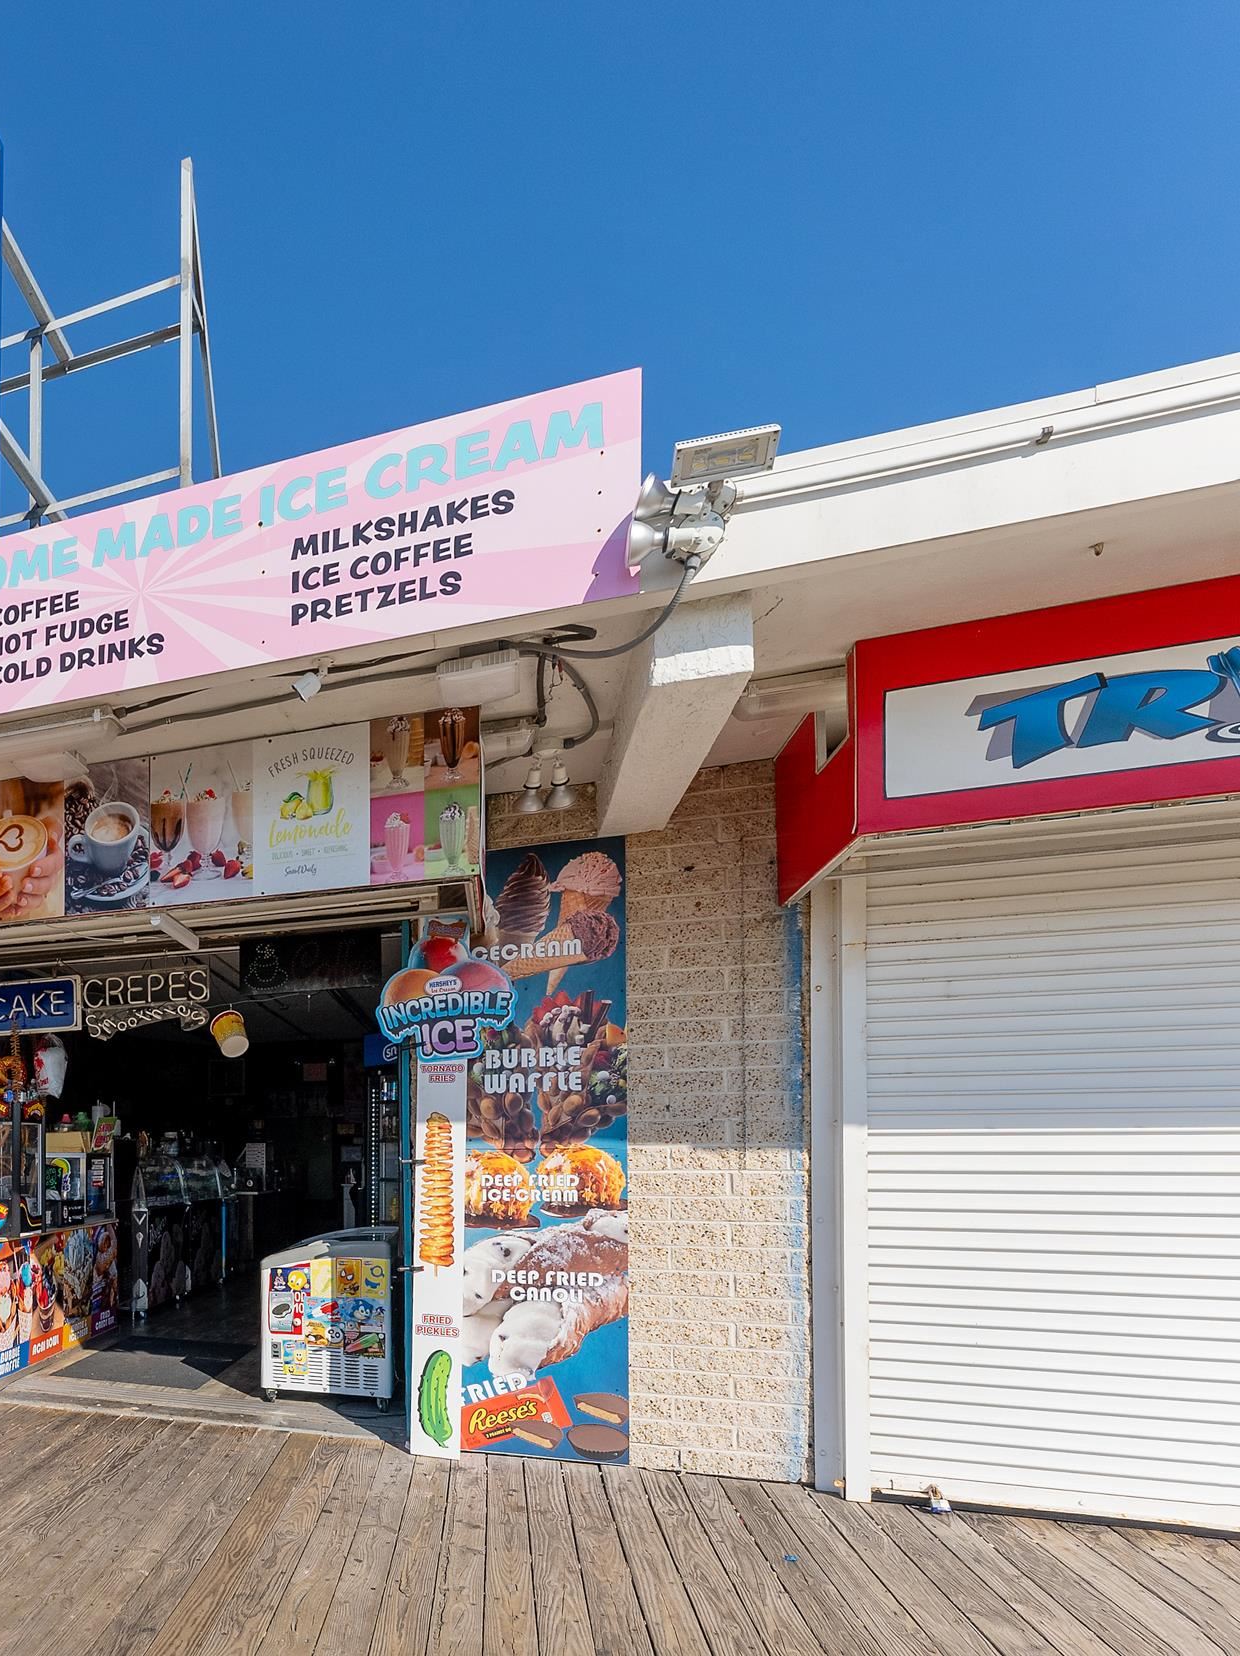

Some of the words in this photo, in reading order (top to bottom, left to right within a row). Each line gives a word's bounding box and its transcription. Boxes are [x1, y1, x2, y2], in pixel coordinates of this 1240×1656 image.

[92, 495, 243, 568] MADE
[260, 466, 348, 527] ICE
[364, 401, 605, 499] CREAM
[290, 488, 516, 561] MILKSHAKES
[290, 562, 341, 594] ICE
[349, 533, 474, 581] COFFEE
[290, 571, 463, 627] PRETZELS
[44, 609, 130, 647] FUDGE
[59, 632, 165, 673] DRINKS
[268, 752, 299, 778] FRESH
[302, 747, 355, 765] SQUEEZED
[269, 808, 353, 848] Lemonade
[83, 970, 208, 1009] CREPES
[382, 992, 512, 1030] INCREDIBLE
[422, 1019, 478, 1055] ICE
[420, 1064, 464, 1073] TORNADO
[485, 1047, 581, 1069] BUBBLE
[429, 1074, 456, 1083] FRIES
[484, 1071, 582, 1094] WAFFLE
[480, 1173, 524, 1188] DEEP
[527, 1173, 581, 1188] FRIED
[482, 1188, 579, 1203] ICE-CREAM
[491, 1269, 542, 1286] DEEP
[545, 1270, 604, 1288] FRIED
[509, 1285, 583, 1304] CANOLI
[422, 1314, 453, 1325] FRIED
[46, 1335, 59, 1350] BOWL
[416, 1325, 459, 1338] PICKLES
[0, 1346, 20, 1363] BUBBLE
